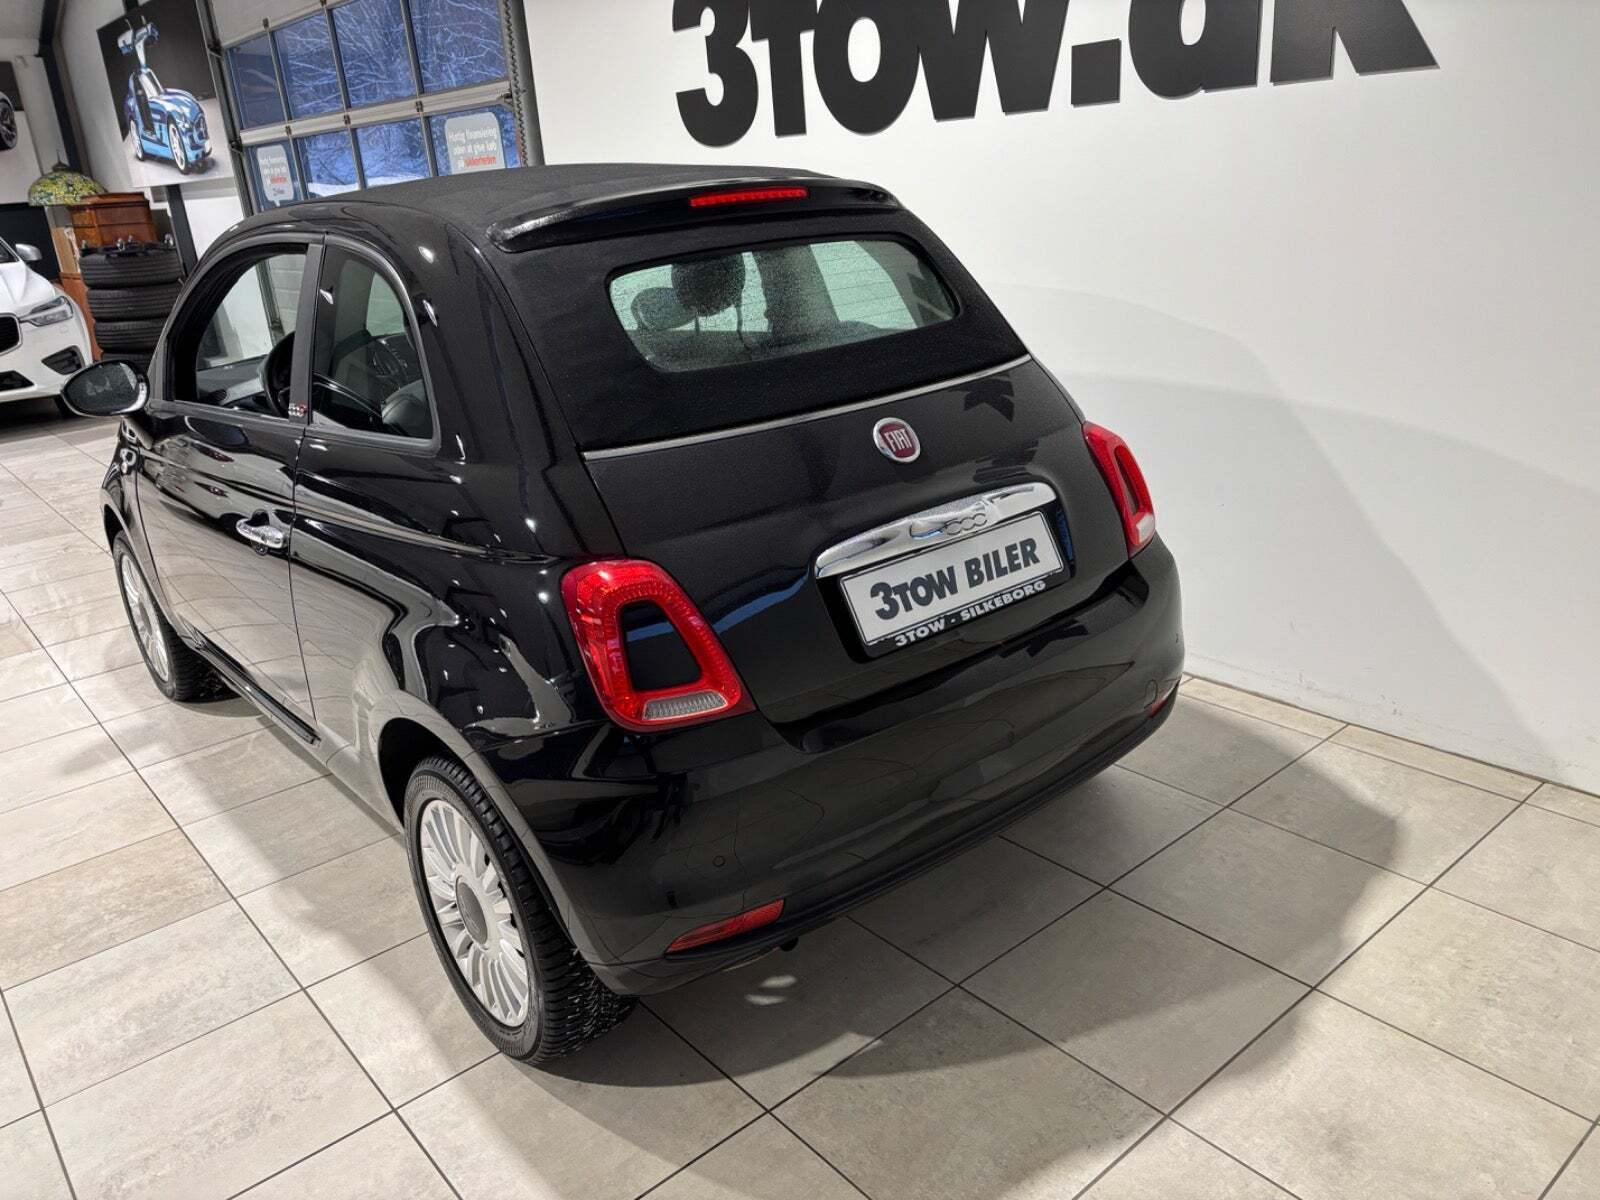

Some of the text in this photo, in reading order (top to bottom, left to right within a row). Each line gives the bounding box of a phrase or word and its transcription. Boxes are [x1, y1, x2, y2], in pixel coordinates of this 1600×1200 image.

[884, 428, 913, 452] FIAT
[870, 537, 1041, 621] 3TOW BILER
[894, 617, 947, 647] 3TOW
[959, 580, 1047, 621] SILKEBORG
